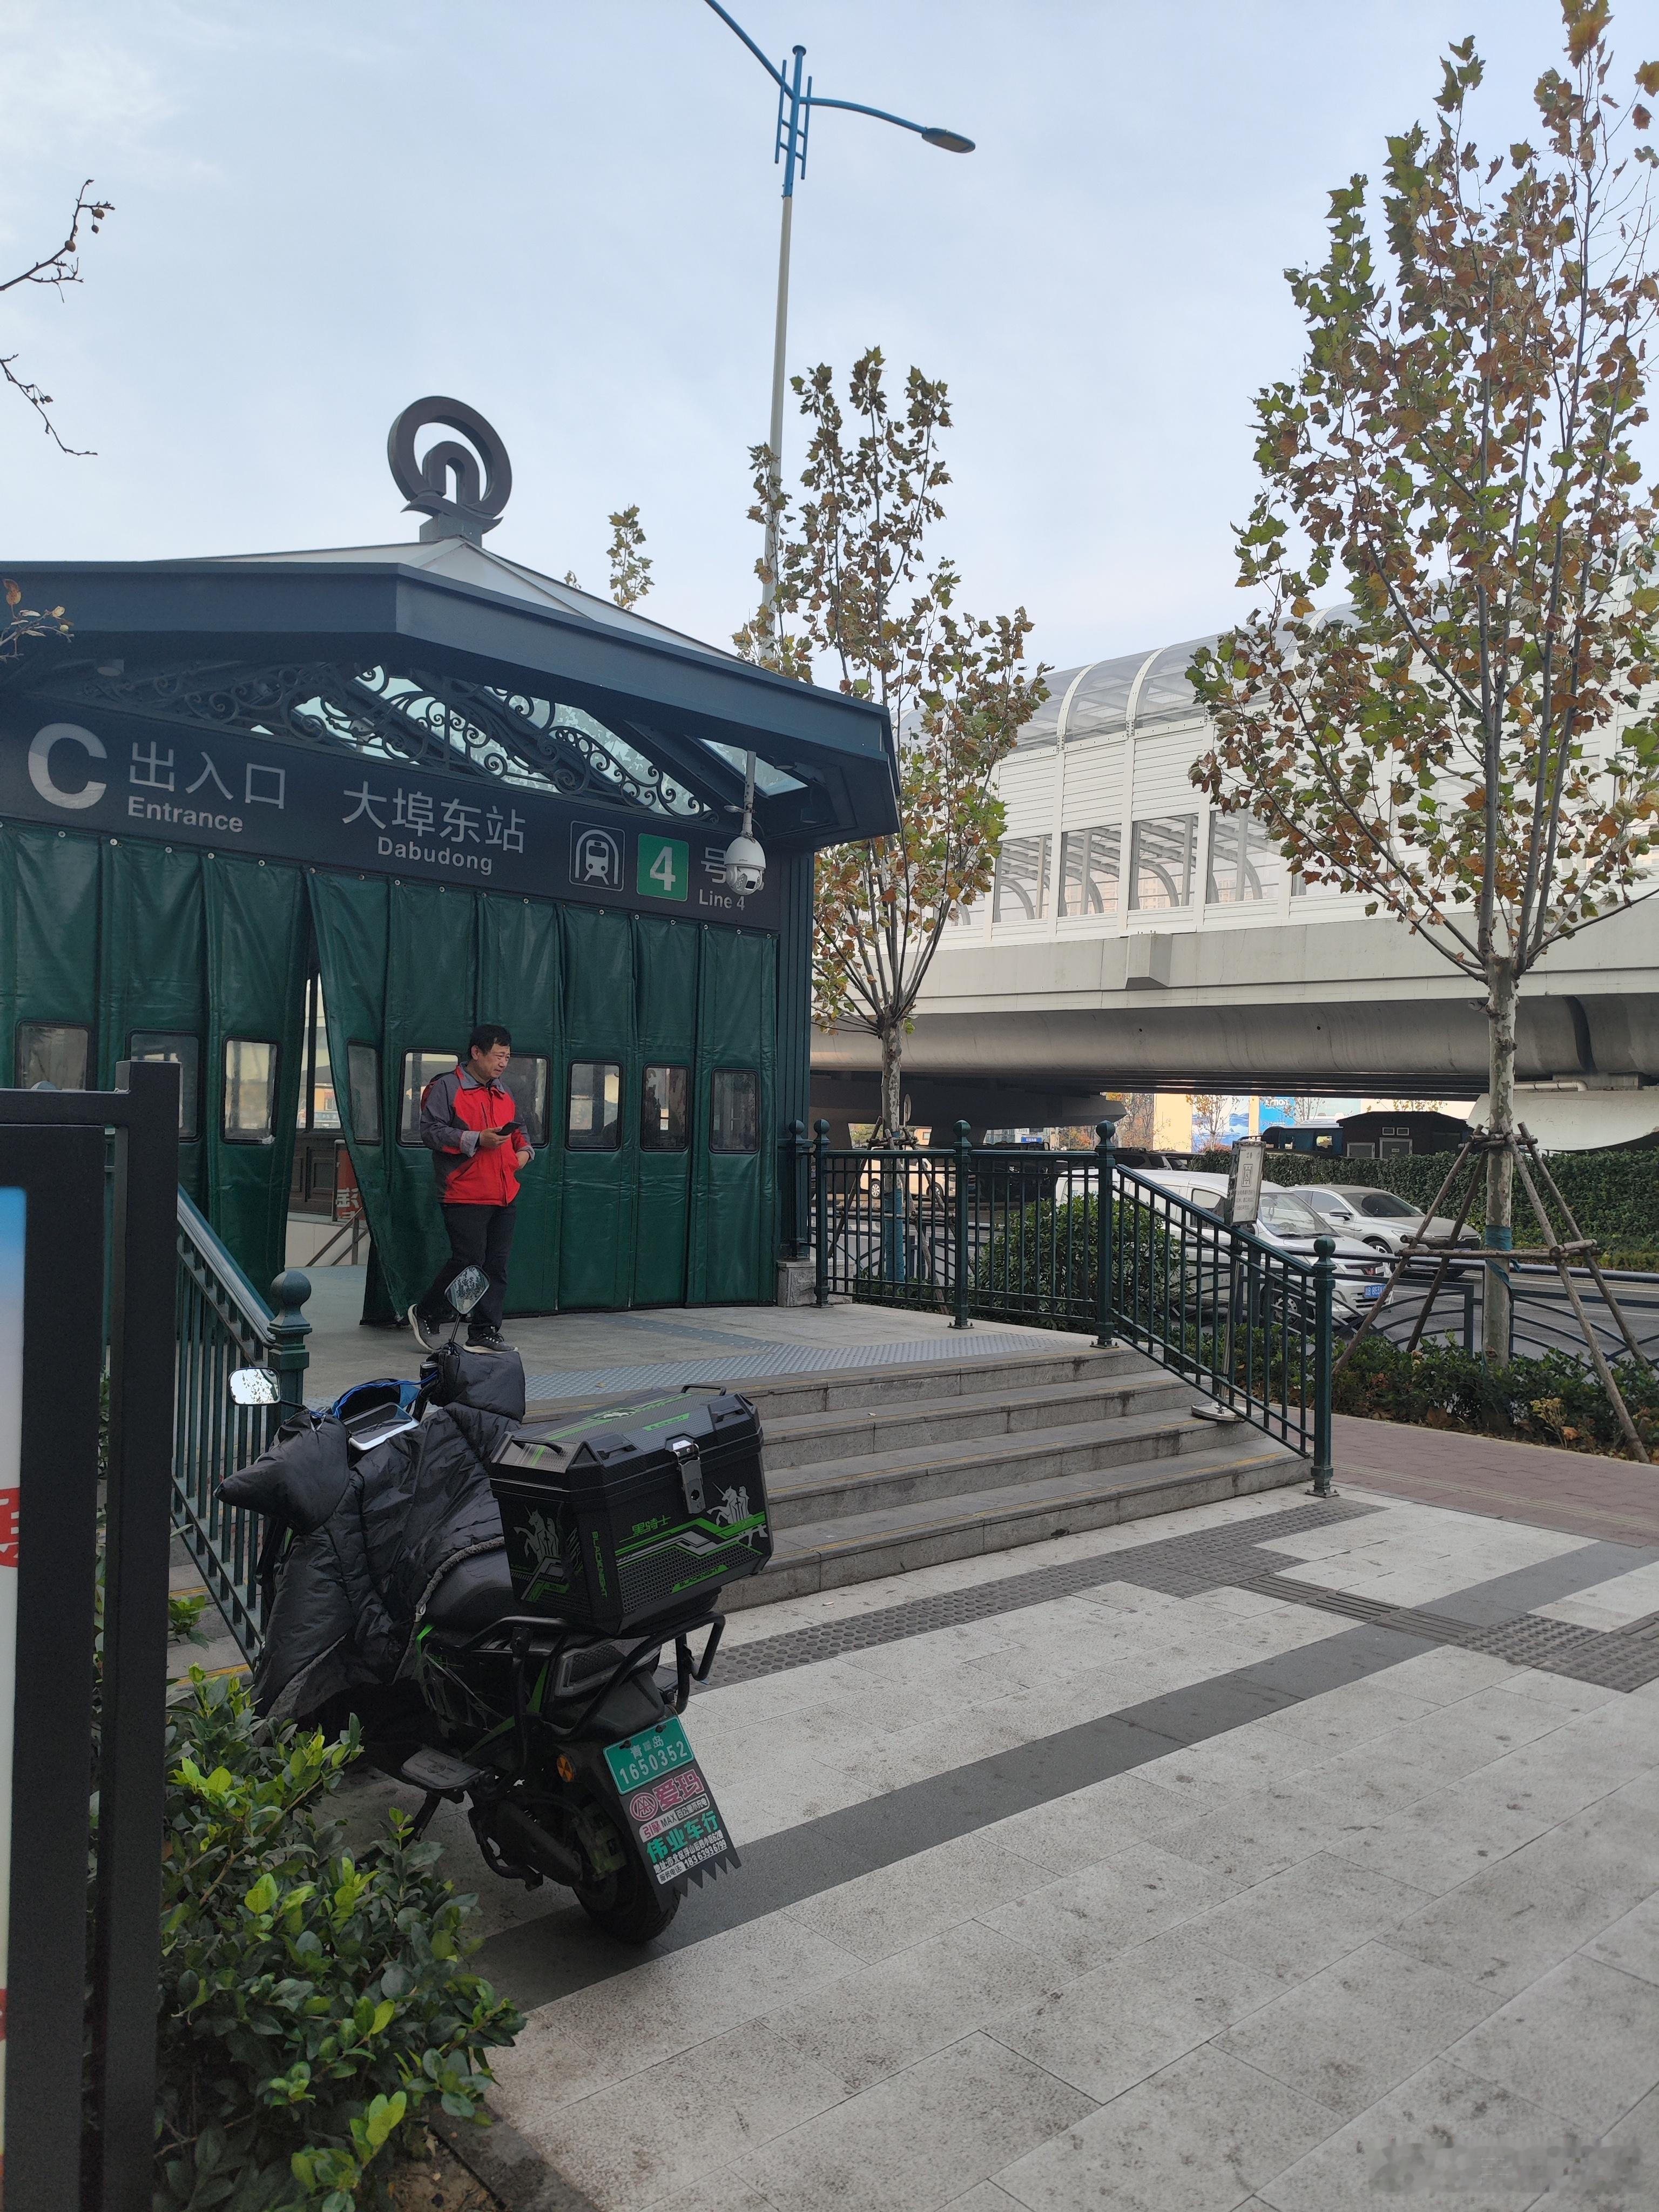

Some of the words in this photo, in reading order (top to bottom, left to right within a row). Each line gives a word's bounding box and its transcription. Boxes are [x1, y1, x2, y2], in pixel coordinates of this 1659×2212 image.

[28, 723, 107, 809] C
[129, 740, 286, 810] 出入口
[128, 797, 243, 833] Entrance
[342, 781, 525, 854] 大埠东站
[378, 835, 493, 875] Dabudong
[650, 846, 676, 891] 4
[699, 889, 732, 908] Line
[736, 896, 745, 911] 4
[632, 1515, 671, 1535] 黑骑士
[679, 1567, 720, 1587] BLACKNIGHT
[619, 1741, 687, 1784] 1650352
[652, 1769, 705, 1812] 爱玛
[647, 1810, 719, 1863] 伟业车行
[660, 1815, 678, 1828] MAX
[684, 1855, 697, 1868] 183
[697, 1847, 714, 1862] 6393
[713, 1839, 727, 1854] 6799
